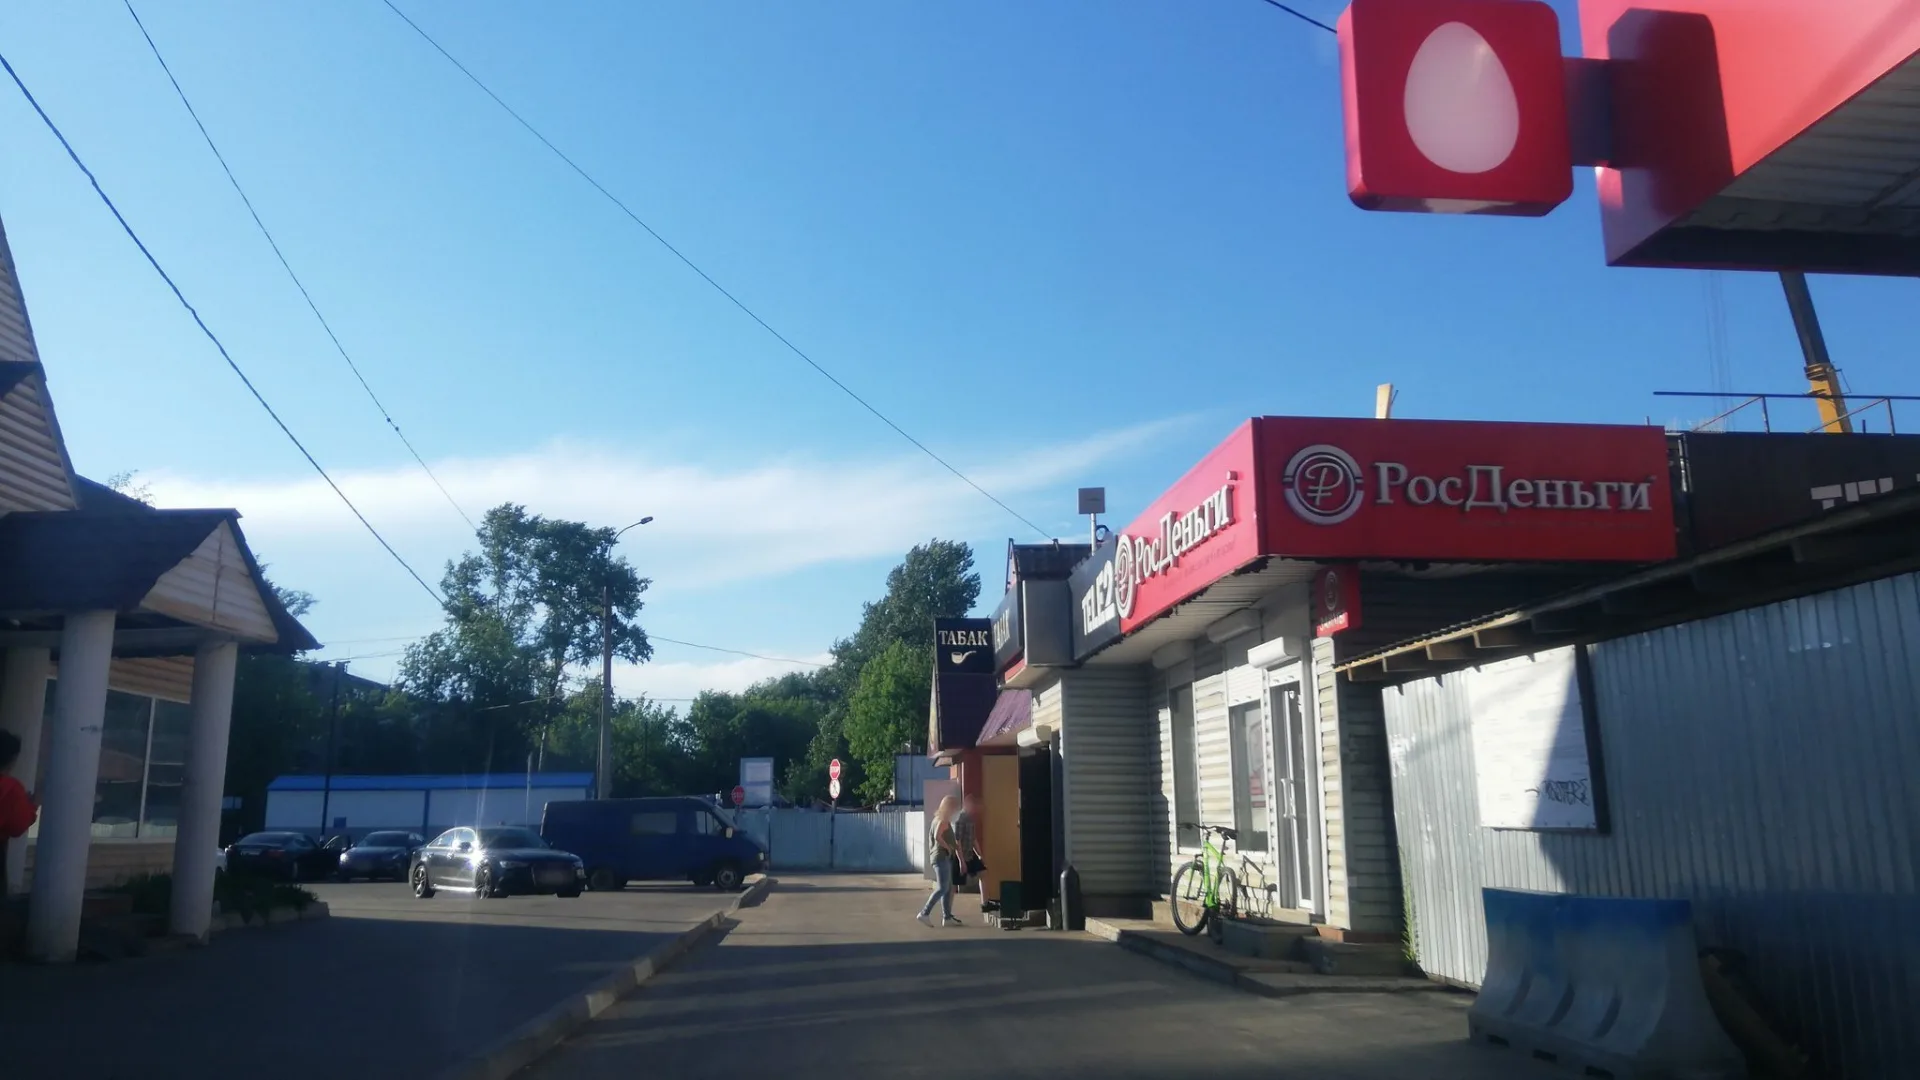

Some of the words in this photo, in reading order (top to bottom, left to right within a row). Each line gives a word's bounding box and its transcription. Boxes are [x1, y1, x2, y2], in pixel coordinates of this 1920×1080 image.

[1373, 461, 1652, 513] РосДеньги
[1134, 484, 1232, 585] РосДеньги
[938, 630, 988, 646] ТАБАК
